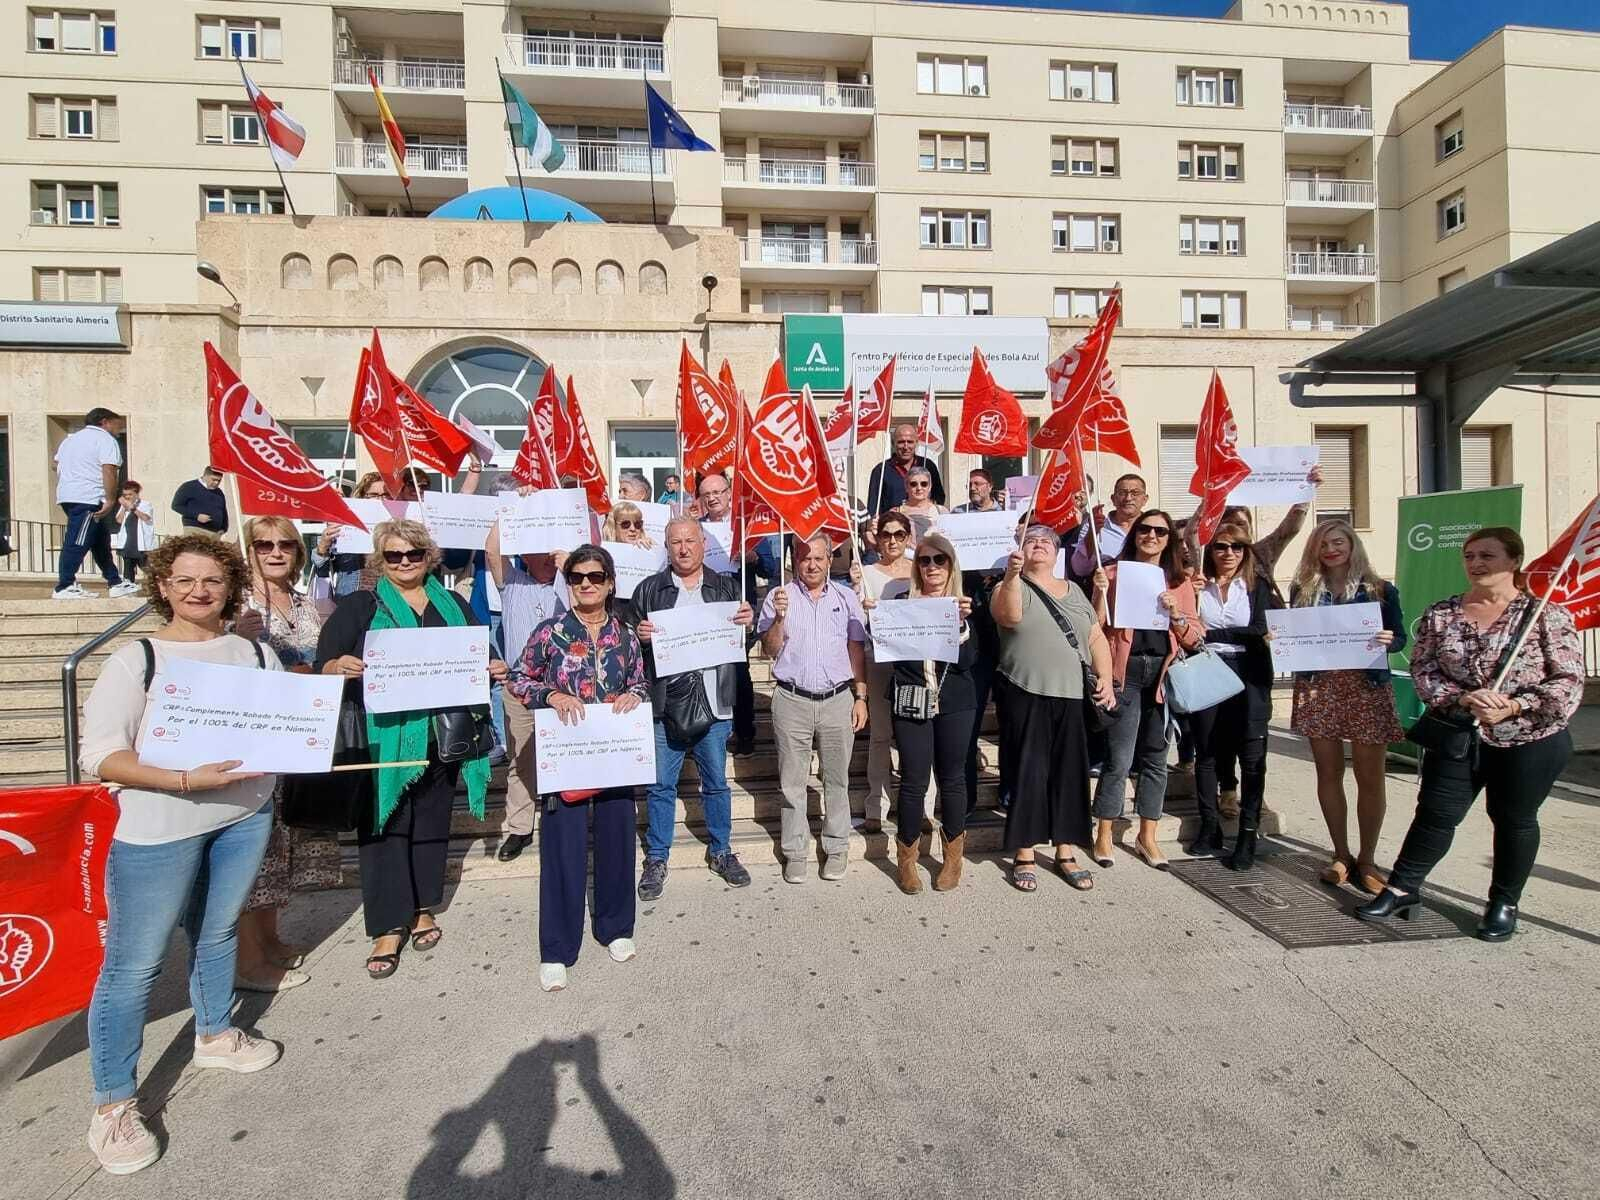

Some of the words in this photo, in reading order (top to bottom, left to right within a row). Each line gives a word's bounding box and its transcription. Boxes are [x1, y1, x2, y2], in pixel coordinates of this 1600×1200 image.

[0, 315, 33, 323] Distrito
[34, 315, 74, 324] Sanitario
[882, 351, 924, 361] Peiférico
[926, 352, 936, 361] de
[937, 352, 1000, 362] Especialdes
[1001, 353, 1020, 361] Bola
[1021, 353, 1040, 361] Azul
[242, 711, 272, 720] Robado
[167, 715, 185, 723] Por
[202, 719, 229, 727] 100%
[232, 721, 248, 729] del
